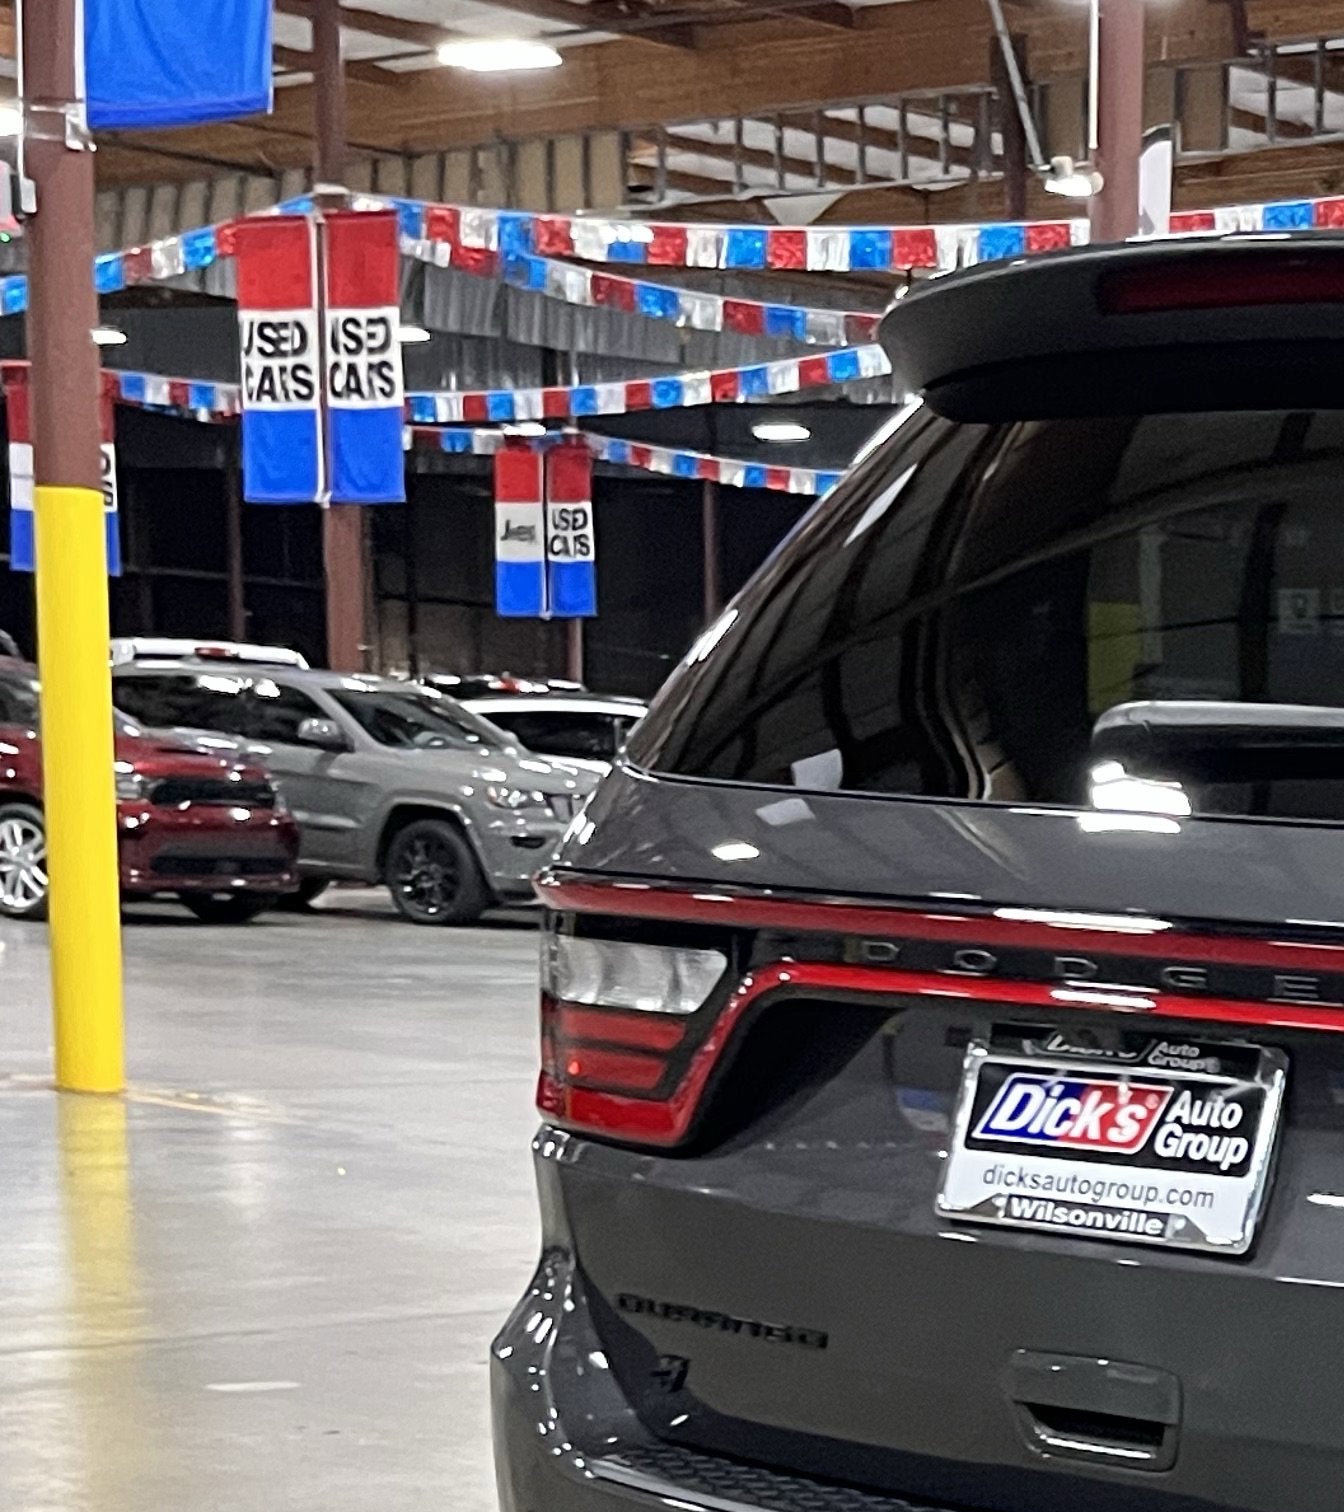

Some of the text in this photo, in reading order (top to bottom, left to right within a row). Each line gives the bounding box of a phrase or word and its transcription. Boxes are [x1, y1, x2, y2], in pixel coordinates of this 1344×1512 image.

[861, 940, 1320, 1001] DODGE
[989, 1083, 1149, 1144] Dick's
[1165, 1090, 1244, 1130] Auto
[1153, 1122, 1250, 1171] Group
[982, 1163, 1215, 1209] dicksautogroup.com
[1009, 1196, 1165, 1236] Wilsonville
